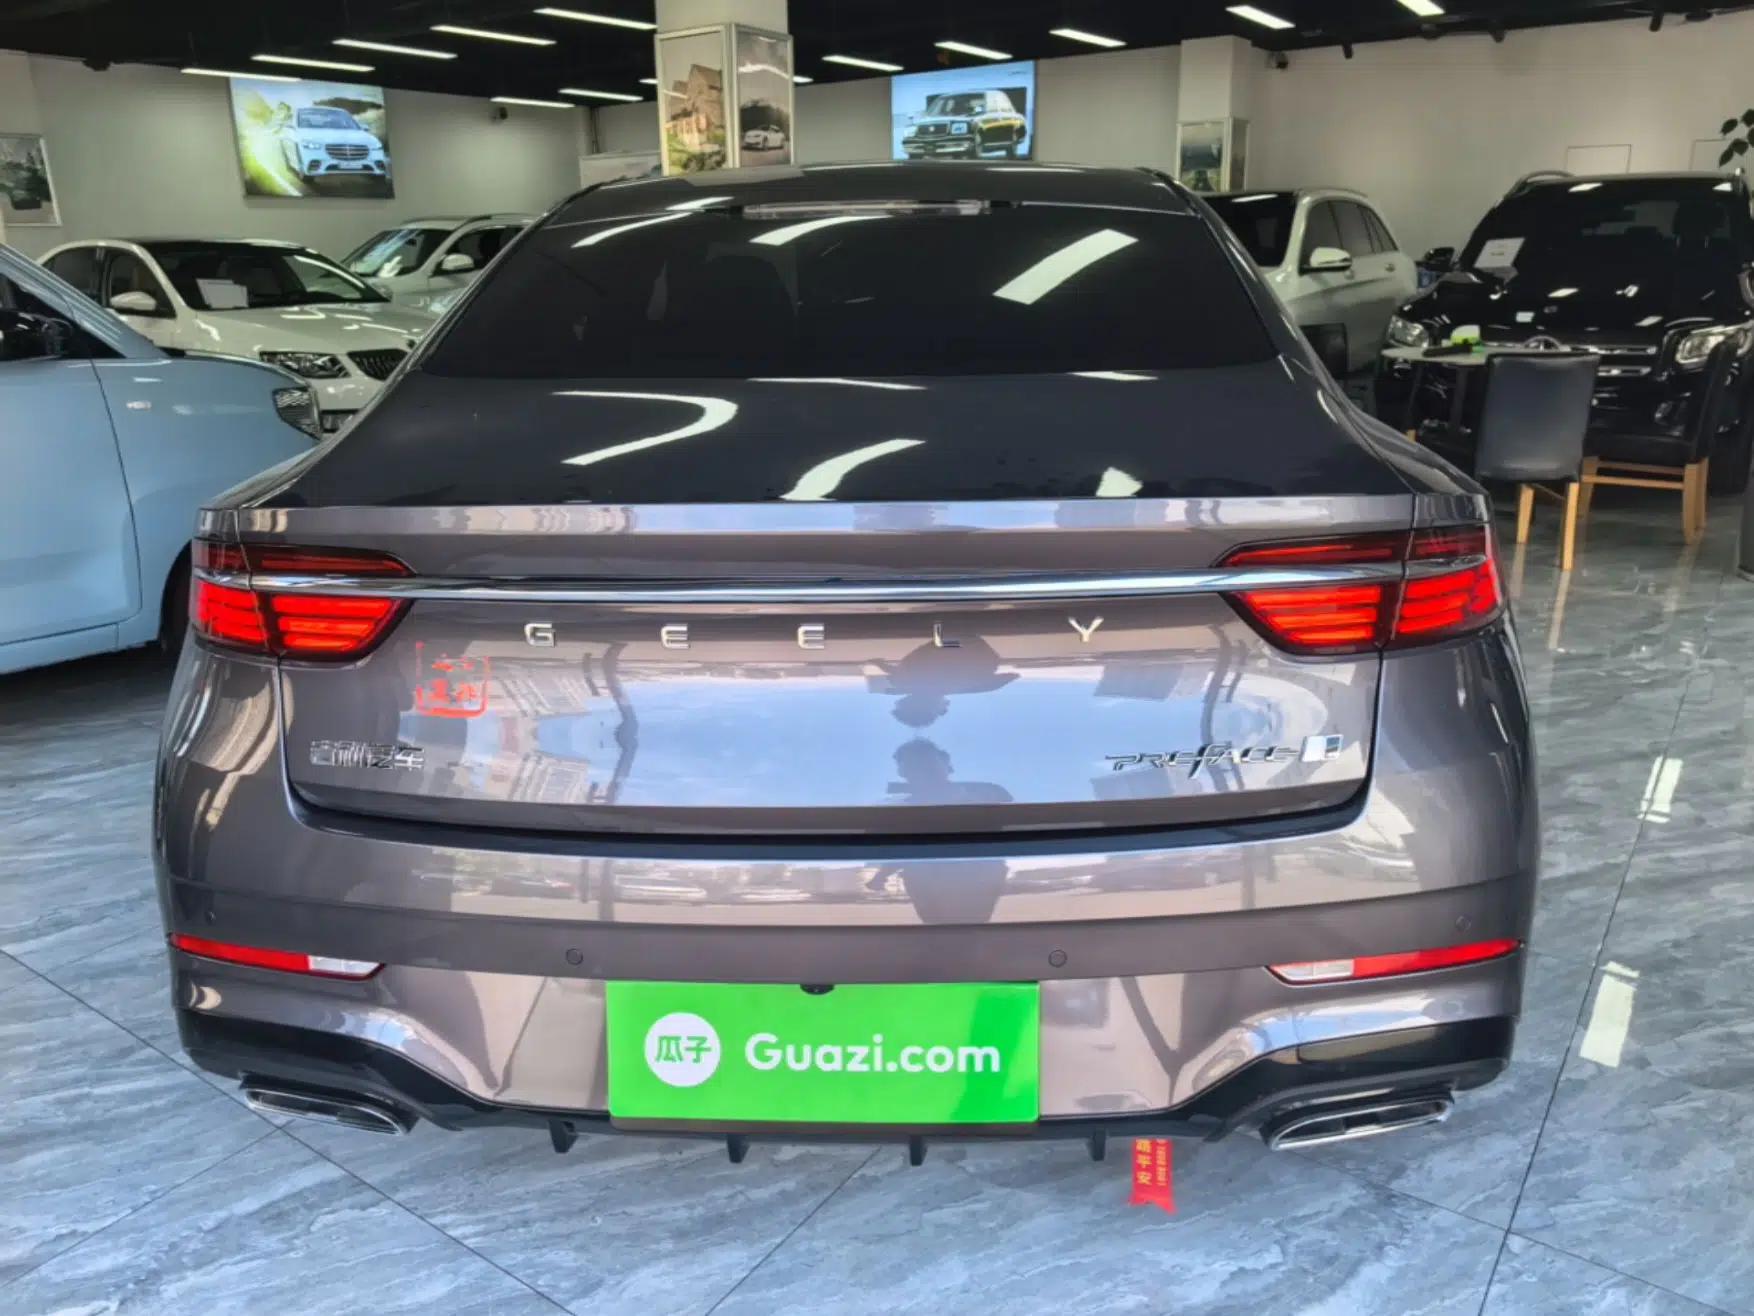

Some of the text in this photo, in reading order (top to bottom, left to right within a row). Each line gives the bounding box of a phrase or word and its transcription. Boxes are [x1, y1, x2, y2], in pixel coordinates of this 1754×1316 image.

[524, 617, 1104, 649] GEELY
[654, 1035, 712, 1065] 瓜子
[745, 1032, 1001, 1073] Guazi.com
